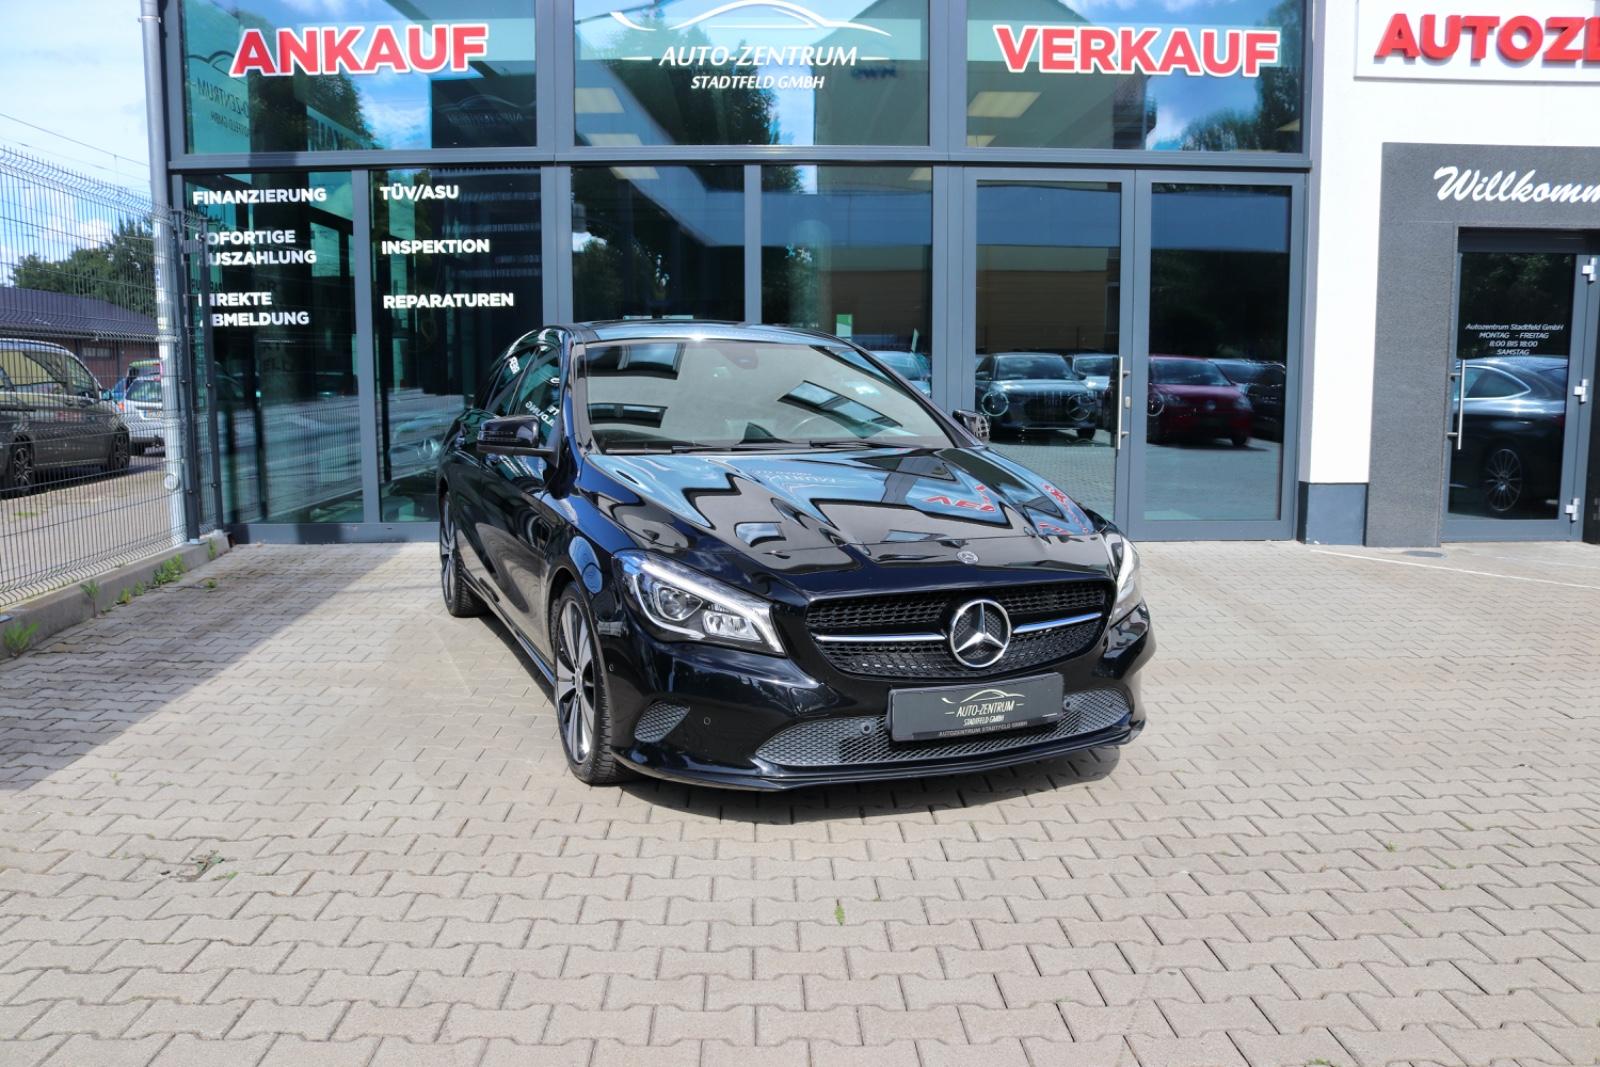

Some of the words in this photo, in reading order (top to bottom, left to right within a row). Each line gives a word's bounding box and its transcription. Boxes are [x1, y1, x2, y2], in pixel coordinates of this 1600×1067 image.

[229, 24, 489, 78] ANKAUF
[658, 46, 857, 67] AUTO-ZENTRUM
[993, 24, 1283, 78] VERKAUF
[690, 75, 775, 90] STADTFELD
[777, 75, 826, 90] GMBH
[192, 187, 328, 206] FINANZIERUNG
[379, 182, 460, 202] TÜV/ASU
[381, 238, 491, 255] INSPEKTION
[197, 249, 318, 267] USZAHLUNG
[382, 292, 515, 310] REPARATUREN
[199, 311, 310, 328] BMELDUNG
[1466, 323, 1509, 331] Autozentrum
[1510, 323, 1541, 332] Stadtfeld
[1542, 323, 1564, 331] GmbH
[1496, 348, 1531, 356] SAMSTAG
[955, 700, 1015, 718] AUTO-ZENTRUM
